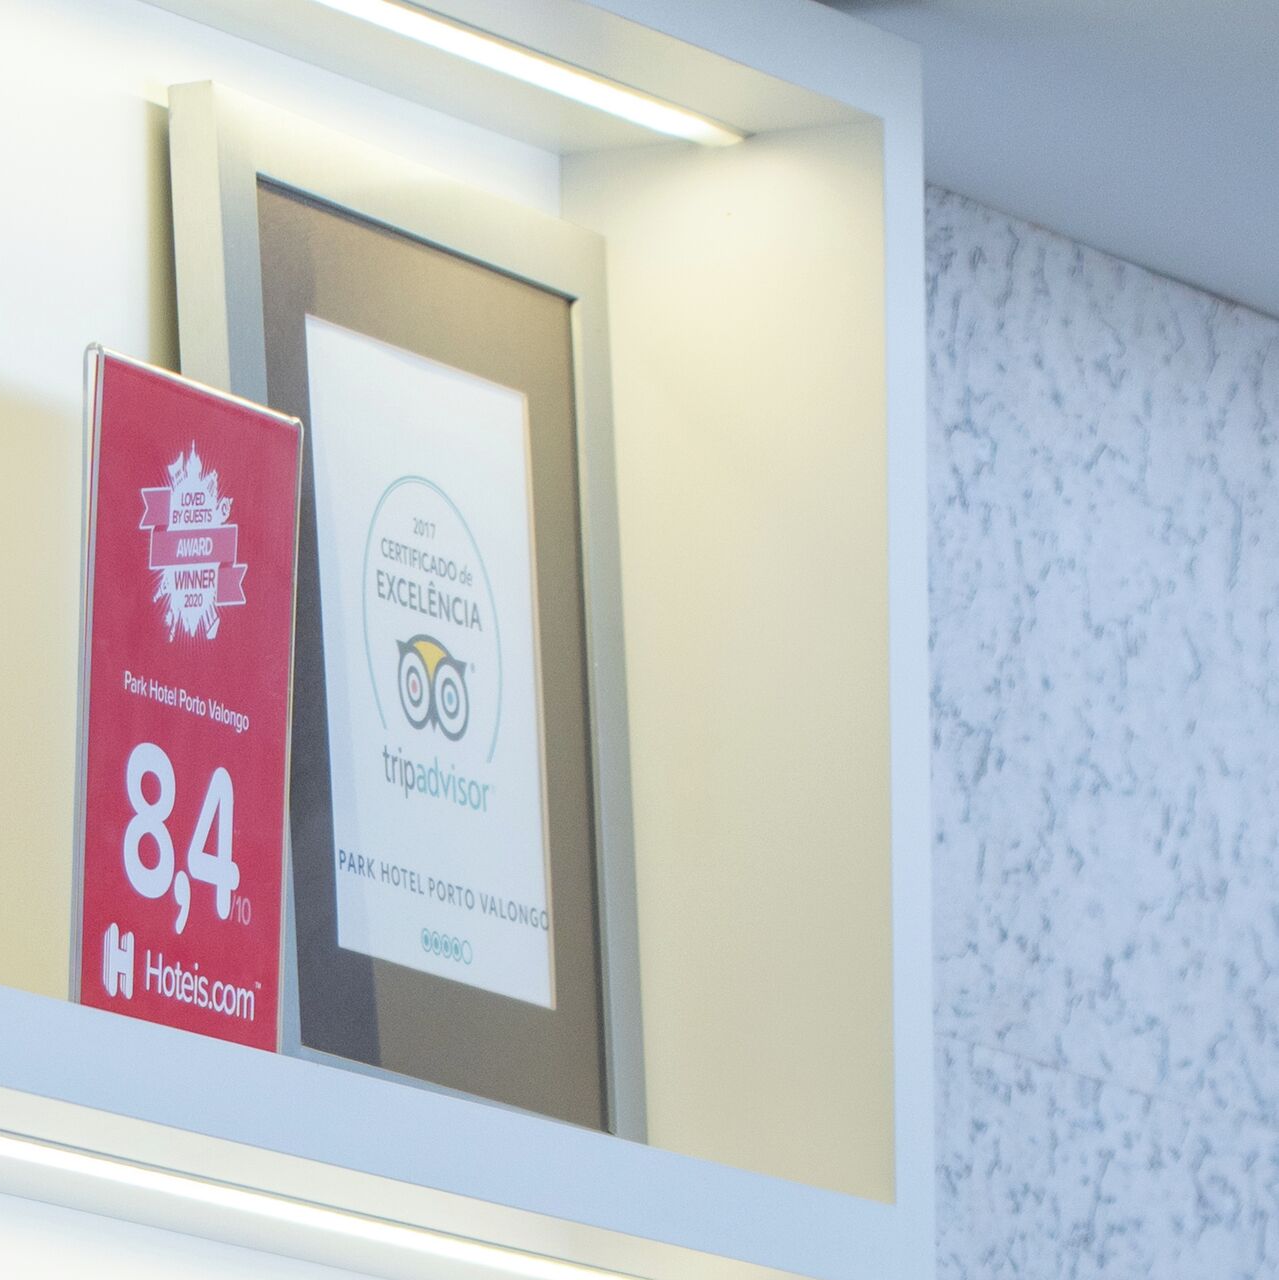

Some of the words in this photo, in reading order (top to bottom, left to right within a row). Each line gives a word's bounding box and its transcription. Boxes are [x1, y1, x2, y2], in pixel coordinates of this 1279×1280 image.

[181, 492, 206, 507] LOVED
[172, 510, 183, 524] BY
[184, 508, 213, 523] GUESTS
[413, 516, 436, 540] 2017
[176, 536, 214, 558] AWARD
[381, 537, 457, 582] CERTIFICADO
[460, 564, 473, 587] de
[174, 568, 216, 590] WINNER
[184, 593, 204, 608] 2020
[376, 569, 483, 632] EXCELÊNCIA
[124, 670, 147, 697] Park
[149, 678, 177, 706] Hotel
[179, 688, 207, 716] Porto
[208, 698, 249, 733] Valongo
[383, 745, 489, 812] tripadvisor
[338, 849, 375, 880] PARK
[380, 861, 424, 896] HOTEL
[428, 877, 475, 911] PORTO
[480, 893, 550, 931] VALONGO
